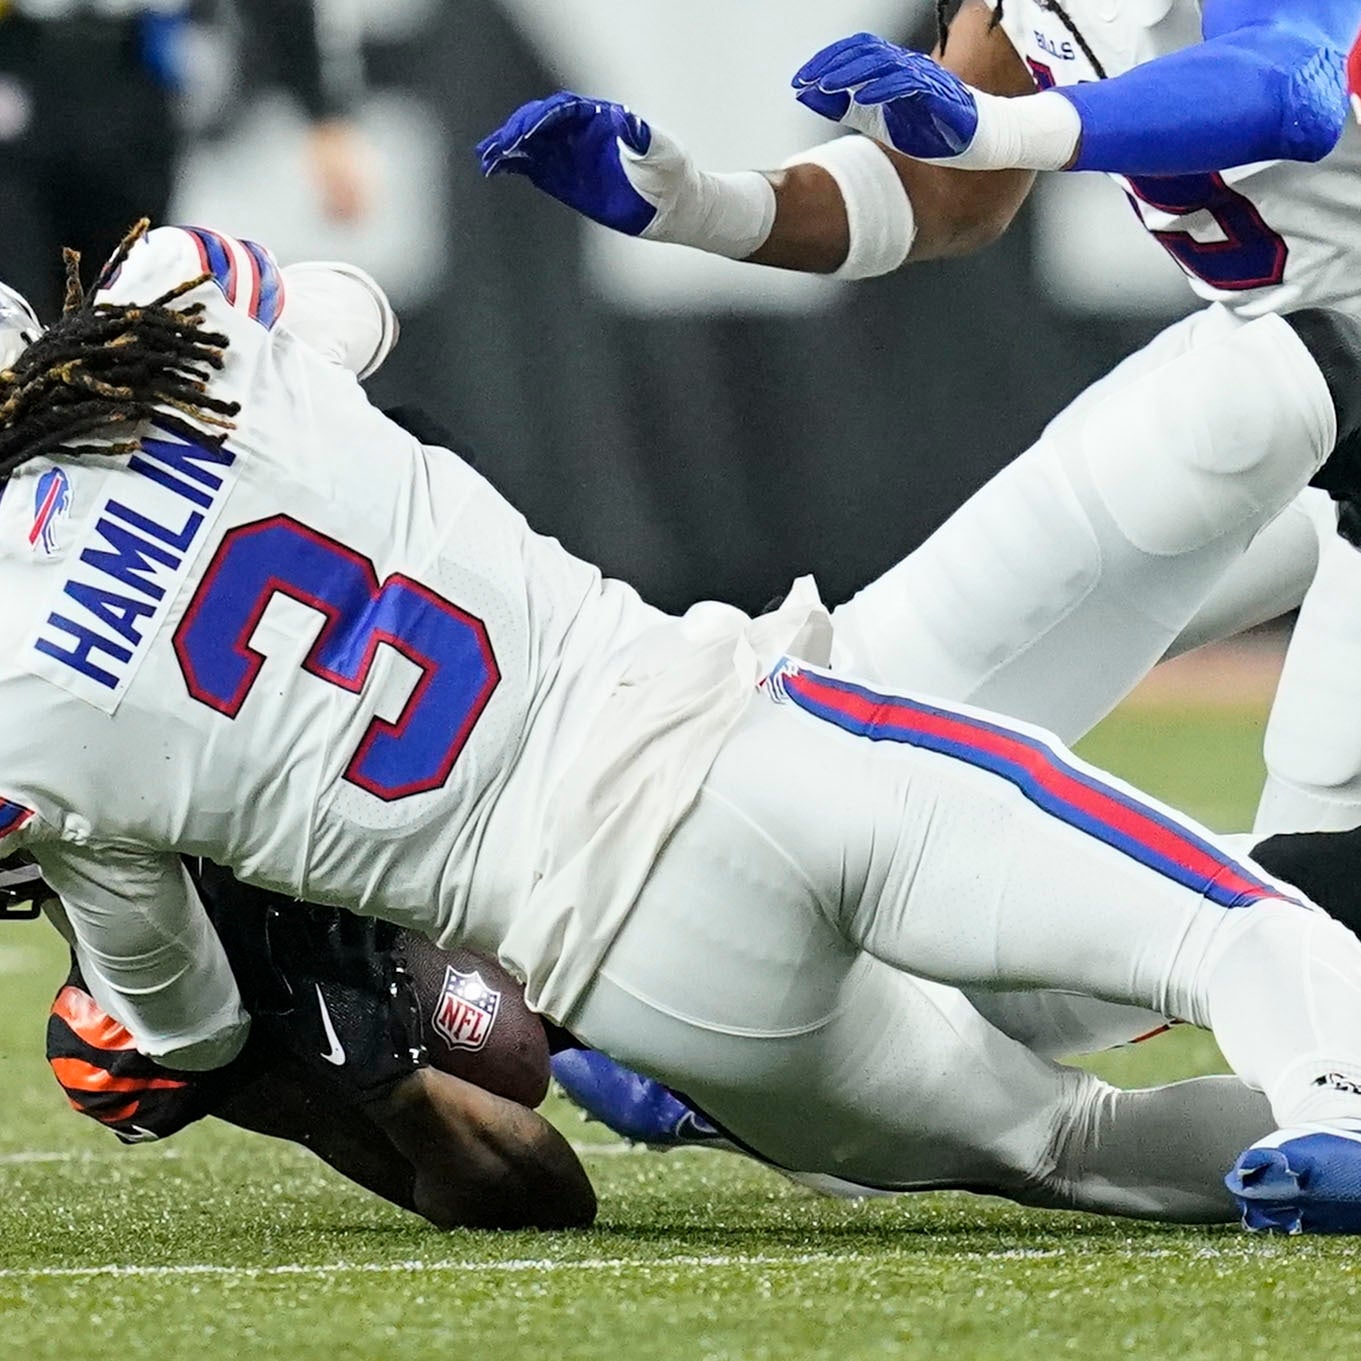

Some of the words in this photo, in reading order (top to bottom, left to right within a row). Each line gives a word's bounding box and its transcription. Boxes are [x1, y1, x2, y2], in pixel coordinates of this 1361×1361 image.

[34, 416, 237, 690] HAMLIN
[172, 512, 502, 802] 3
[438, 995, 484, 1043] NFL
